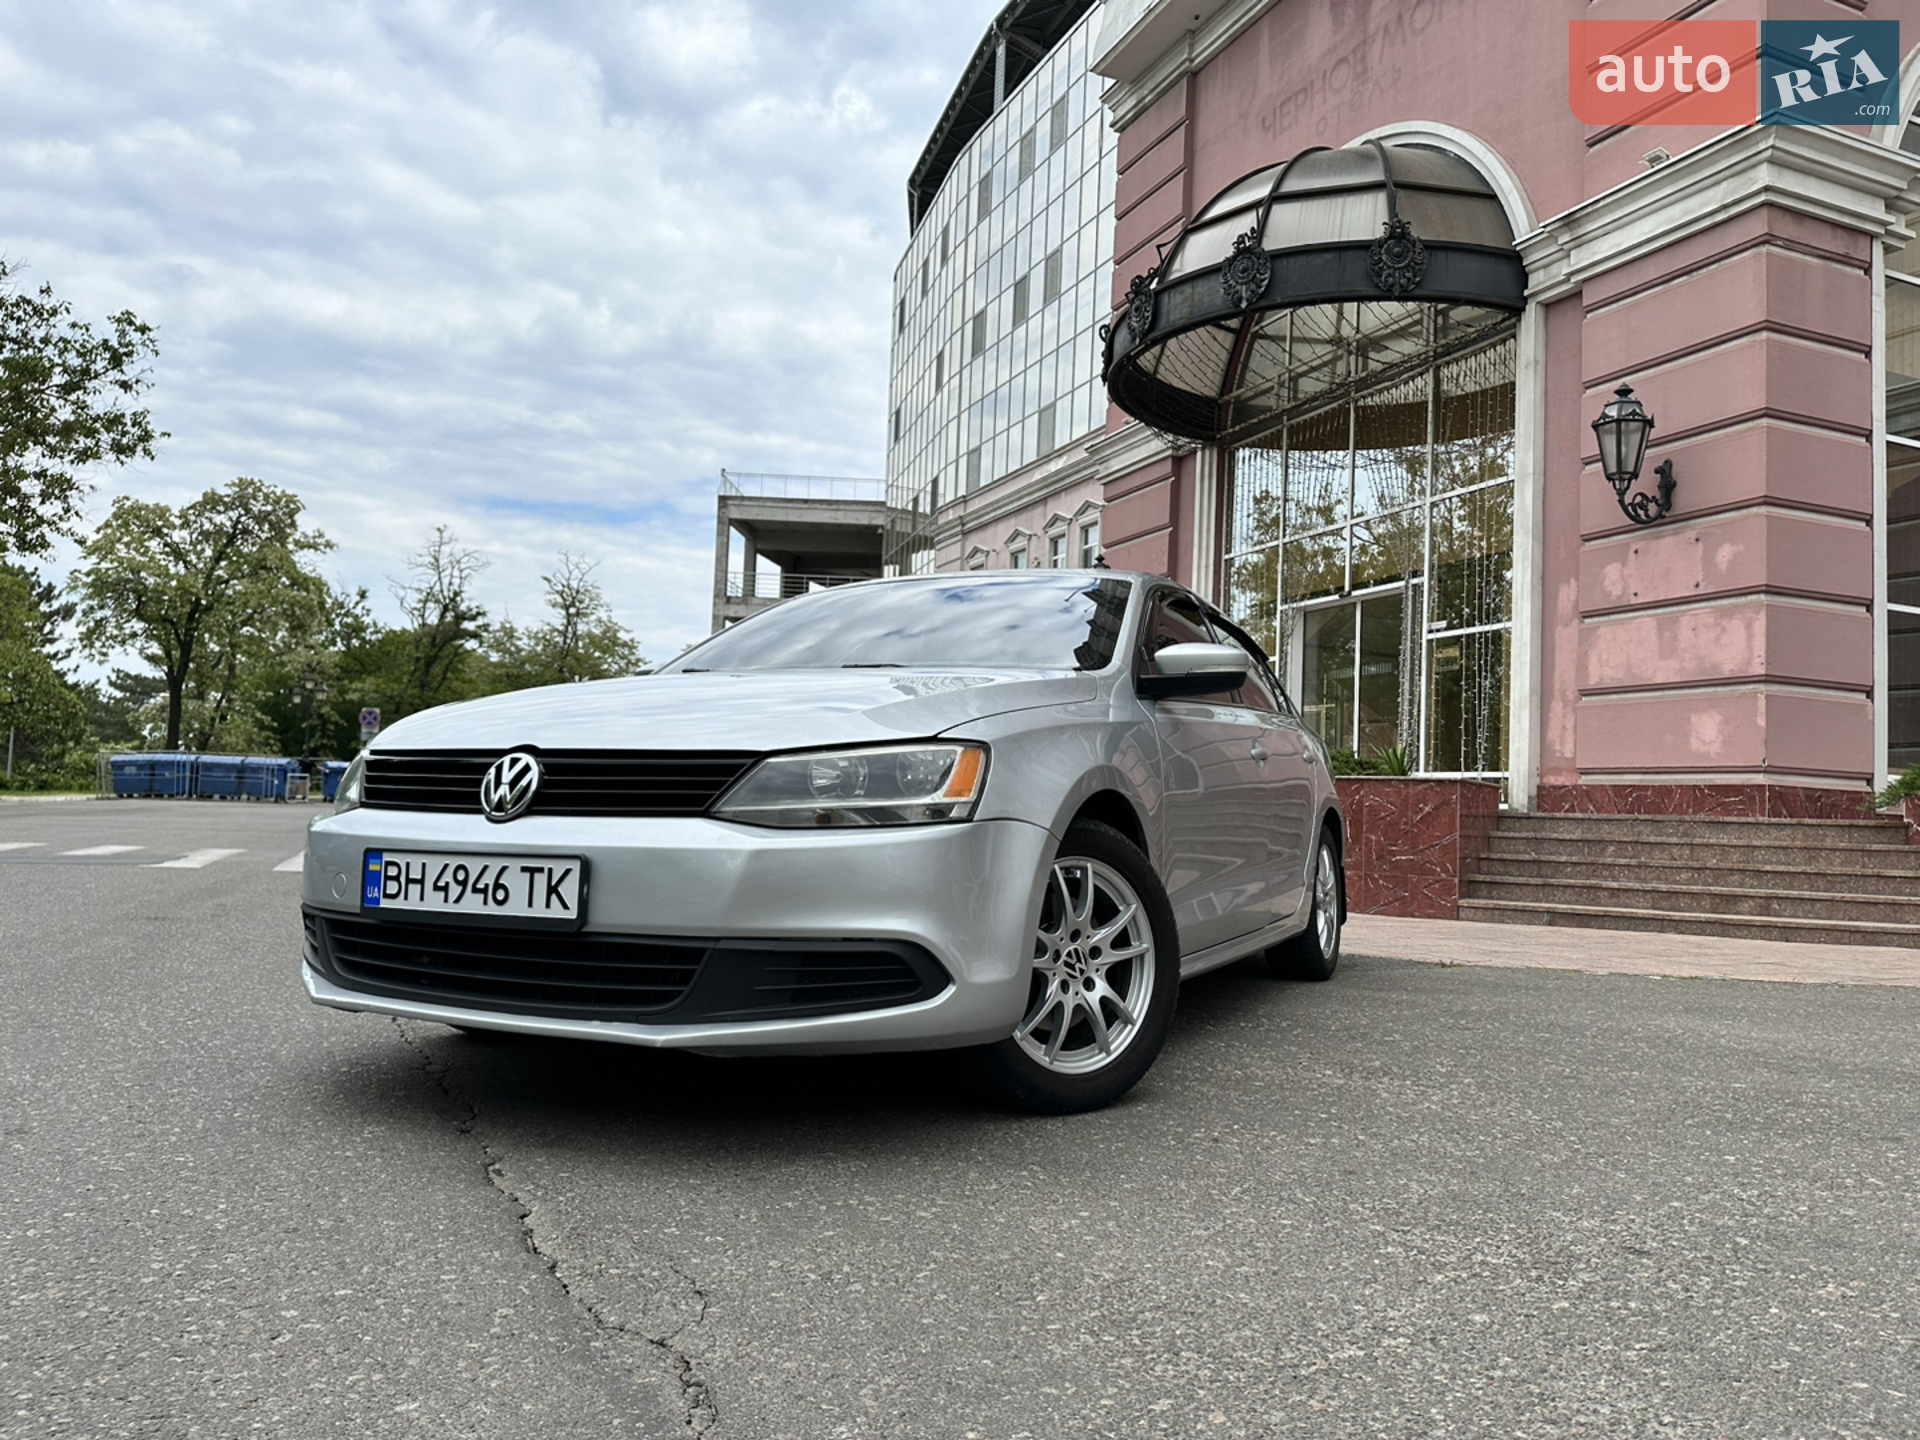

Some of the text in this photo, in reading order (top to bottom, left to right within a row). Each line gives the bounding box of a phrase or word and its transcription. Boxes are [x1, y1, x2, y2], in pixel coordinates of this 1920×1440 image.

[481, 753, 539, 816] VW
[367, 885, 380, 899] UA
[382, 859, 573, 911] BH 4946 TK
